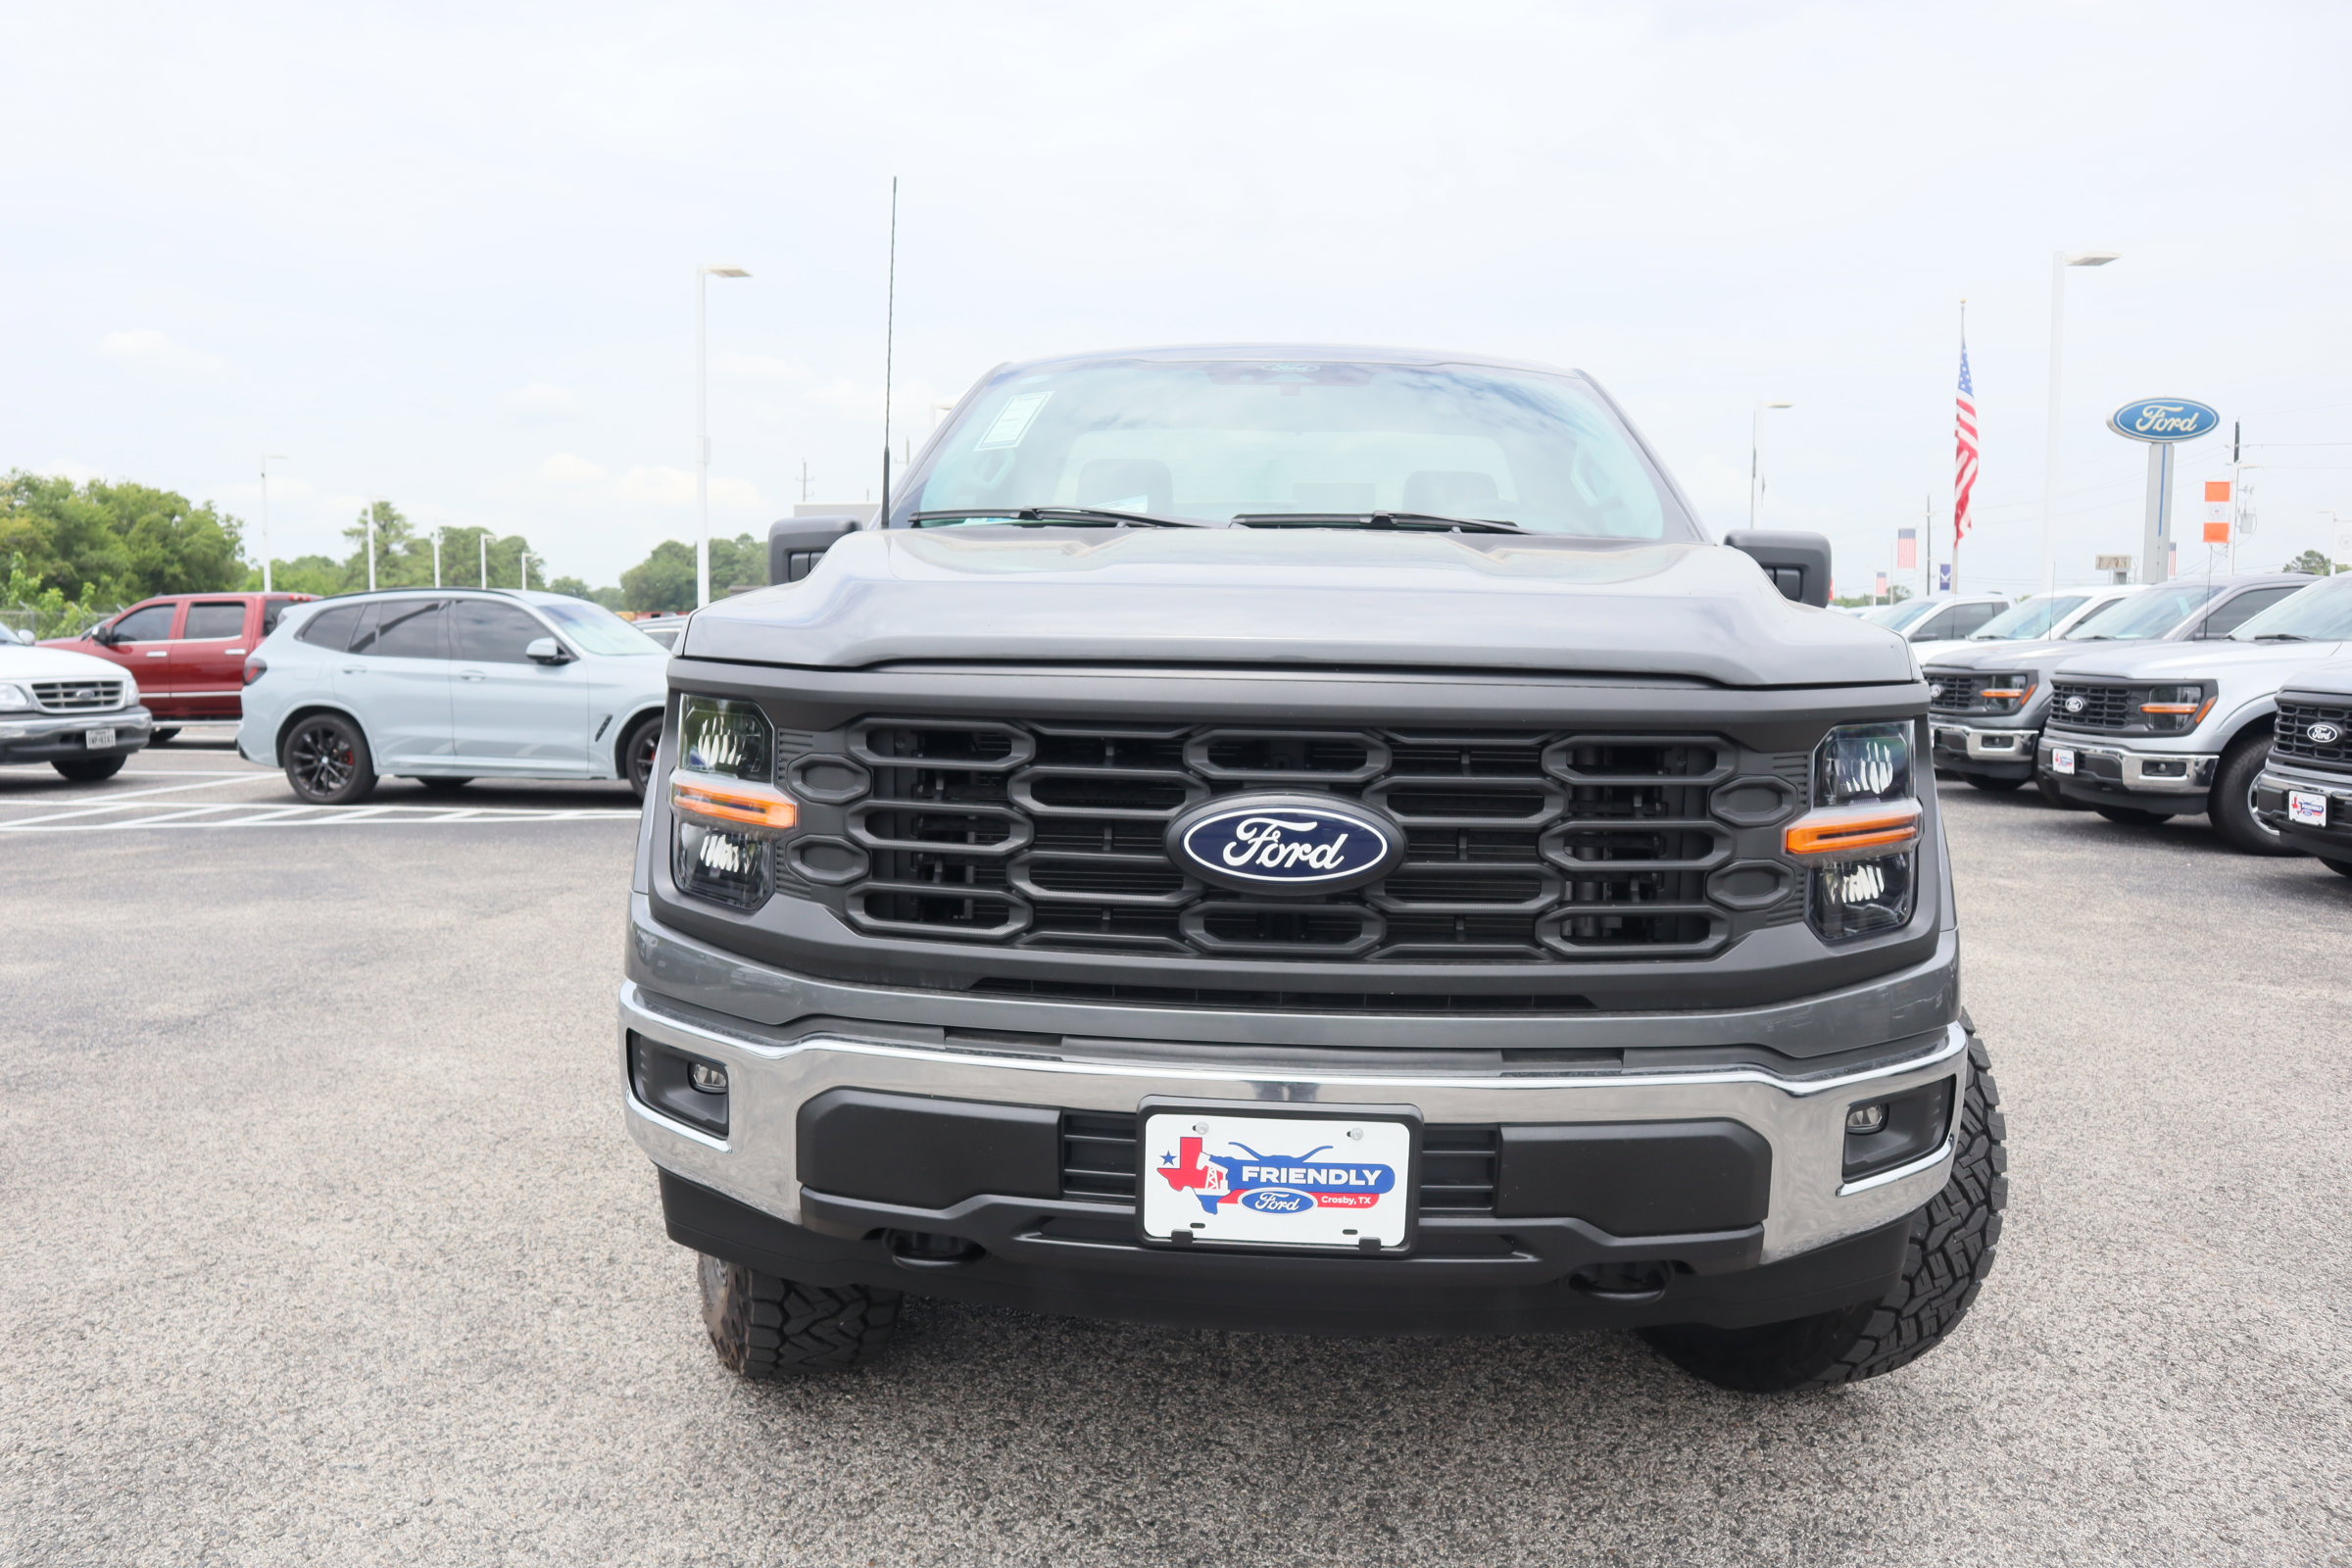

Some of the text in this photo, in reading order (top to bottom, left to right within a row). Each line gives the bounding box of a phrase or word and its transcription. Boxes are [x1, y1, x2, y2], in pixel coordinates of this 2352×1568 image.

[2135, 405, 2199, 431] Ford
[2312, 726, 2331, 740] Ford
[1223, 817, 1348, 868] Ford
[1243, 1166, 1382, 1186] FRIENDLY
[1255, 1193, 1299, 1211] Ford
[1321, 1196, 1356, 1205] Crosby,
